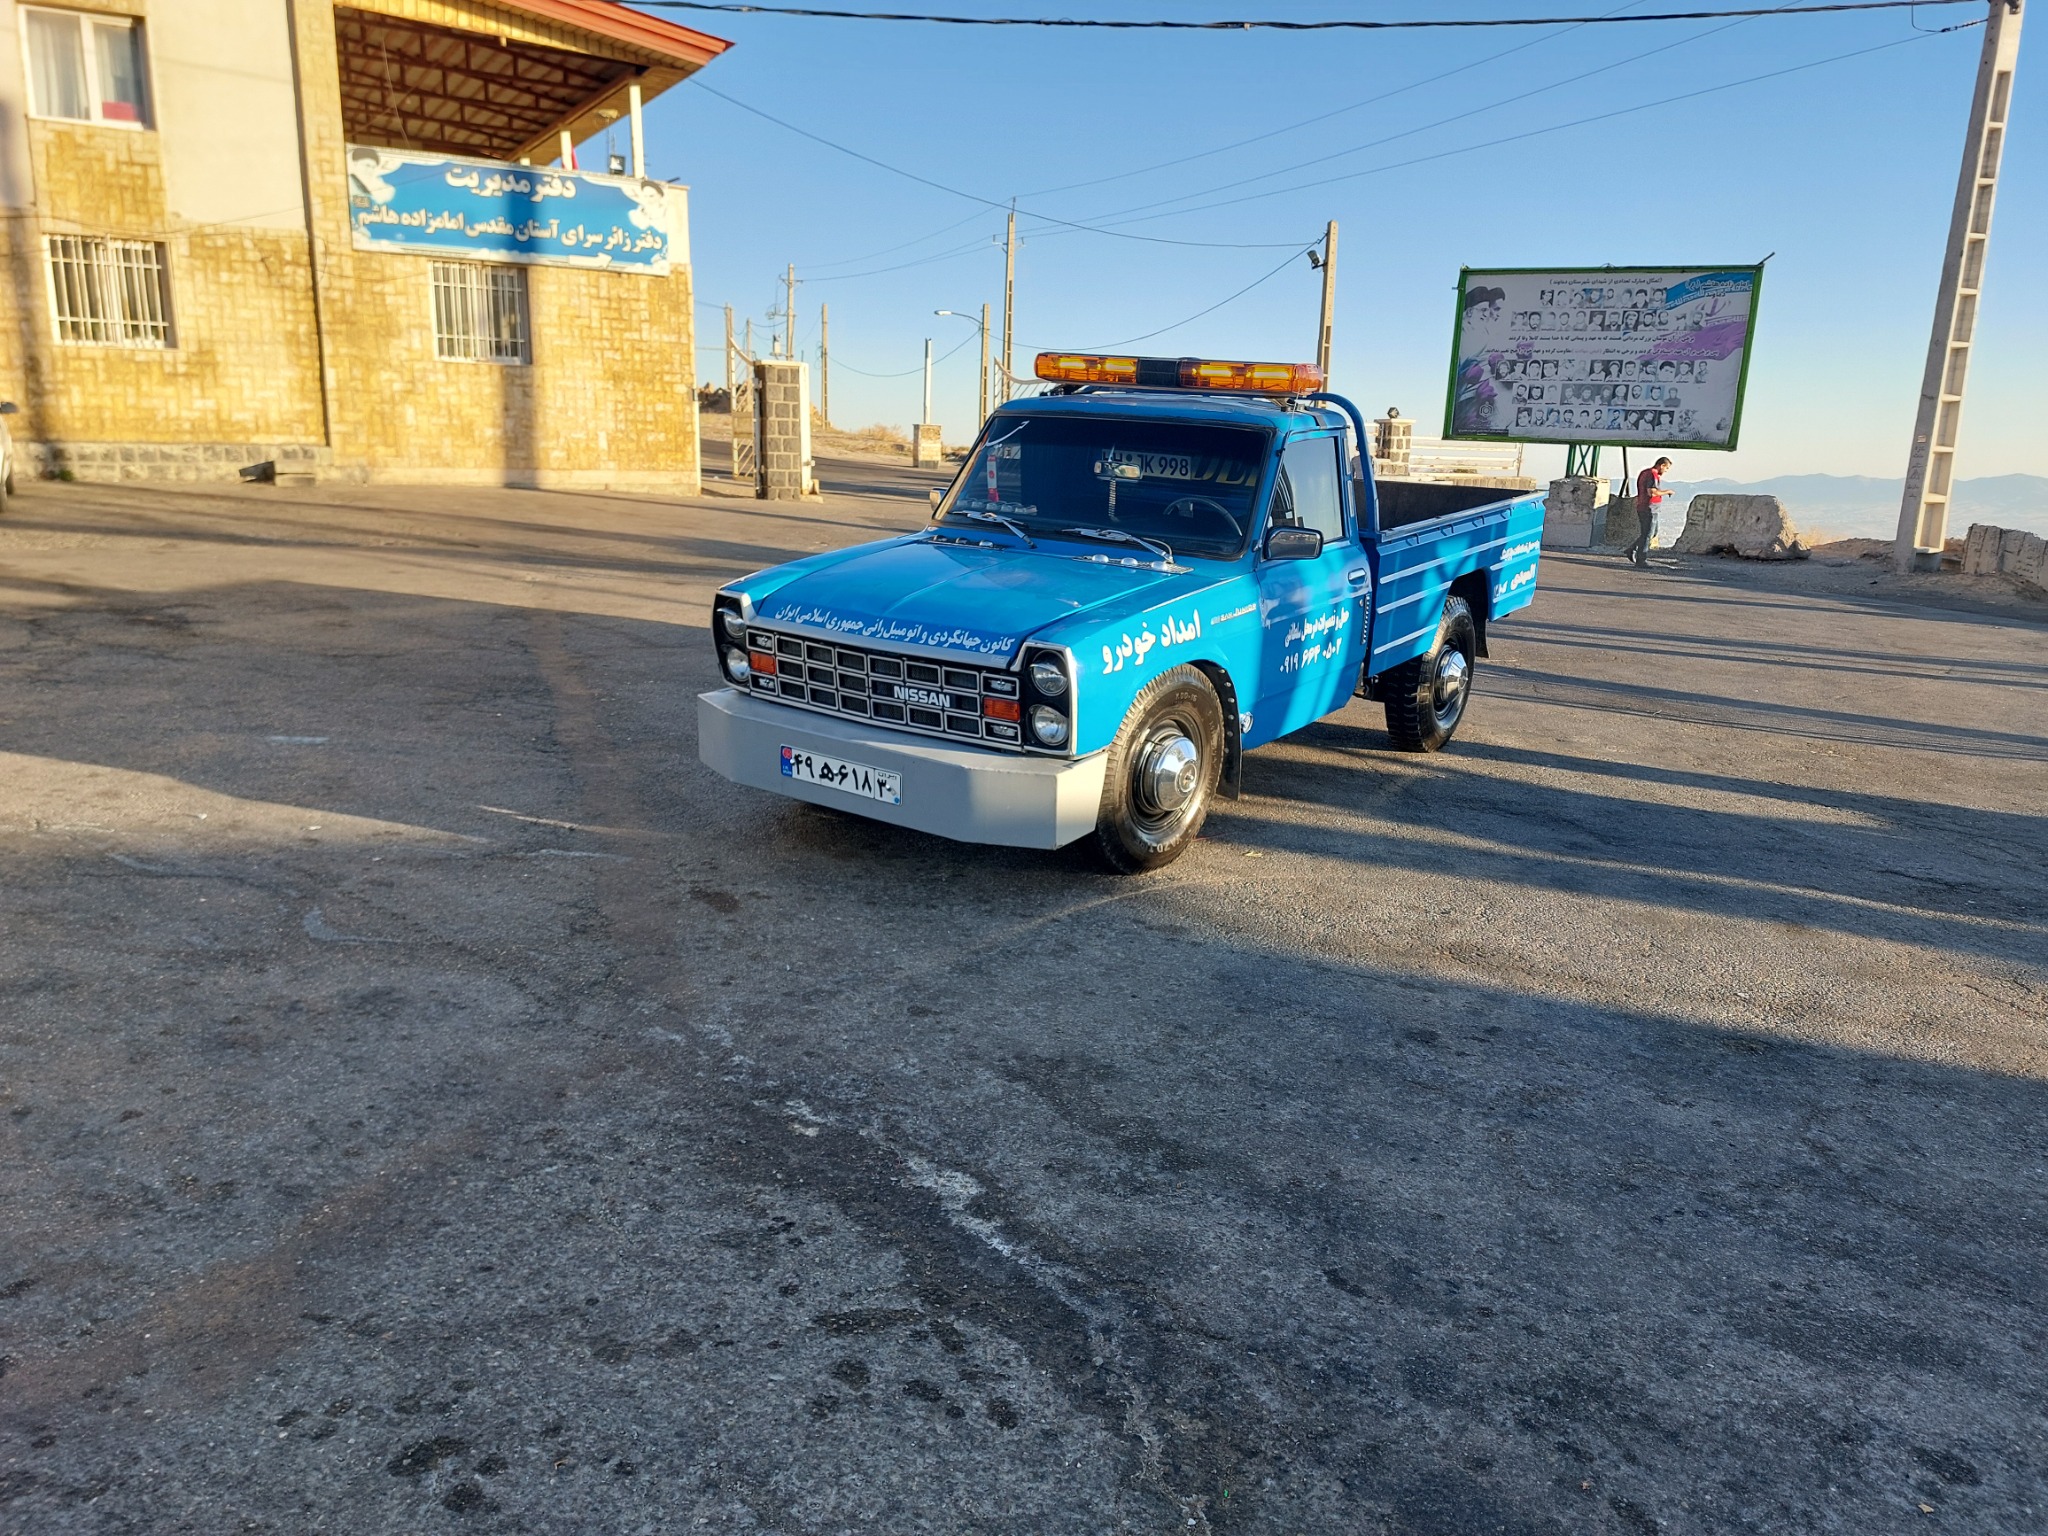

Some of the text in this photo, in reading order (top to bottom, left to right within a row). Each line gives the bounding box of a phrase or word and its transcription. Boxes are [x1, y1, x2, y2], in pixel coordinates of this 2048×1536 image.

[445, 167, 577, 203] دفتر مدیریت
[357, 203, 400, 226] هاشم
[464, 215, 515, 238] مقدس
[515, 218, 560, 242] آستان
[561, 223, 604, 249] سرای
[604, 225, 632, 252] زائر
[632, 229, 663, 254] دفتر
[1158, 456, 1190, 477] 998
[774, 603, 801, 621] ایران
[796, 606, 832, 624] اسلامی
[825, 615, 864, 635] جمهوری
[927, 629, 982, 650] جهانگردی
[979, 636, 1016, 654] کانون
[1102, 608, 1201, 675] امداد خودرو
[893, 685, 951, 708] NISSAN
